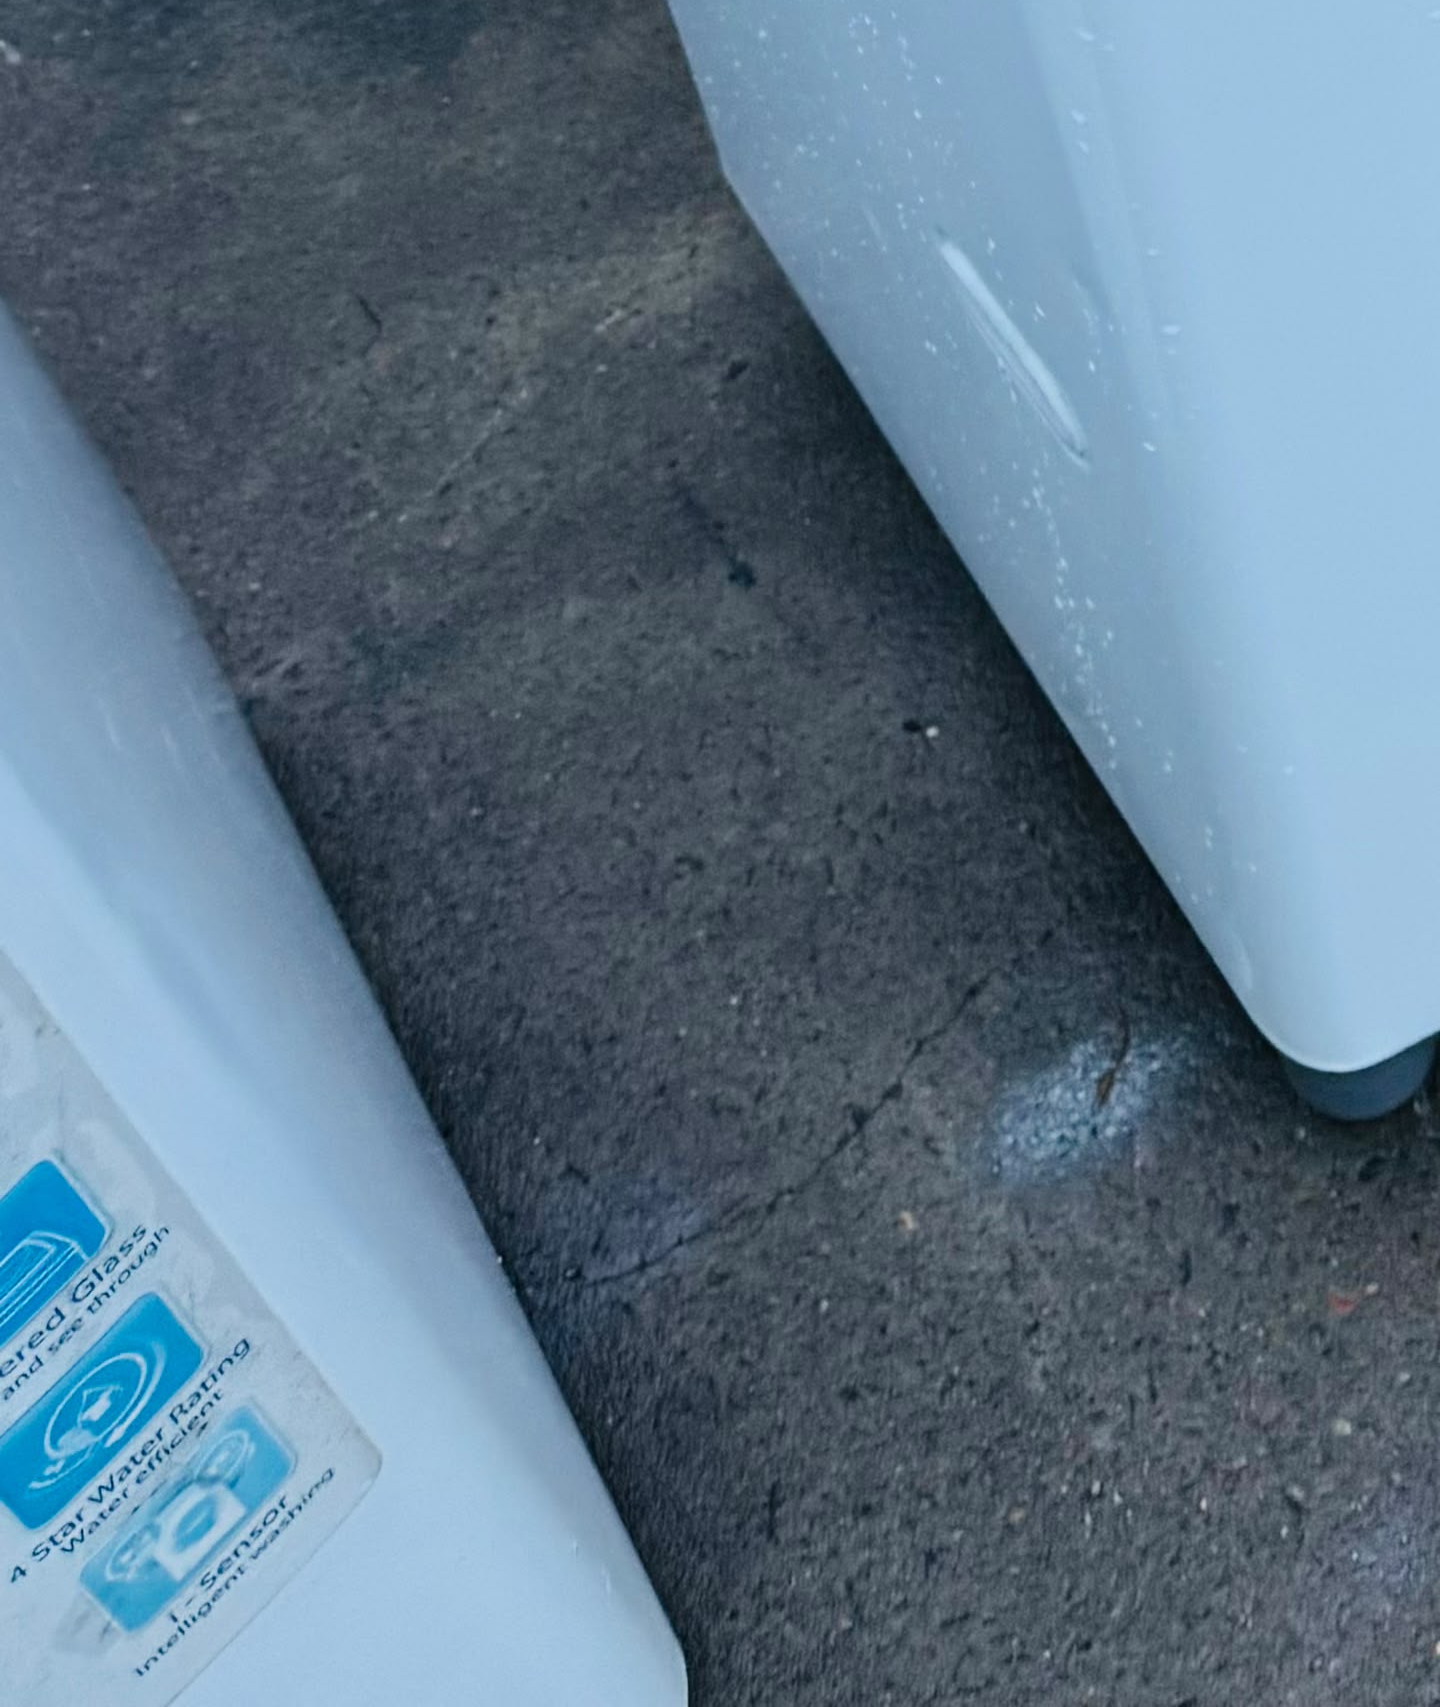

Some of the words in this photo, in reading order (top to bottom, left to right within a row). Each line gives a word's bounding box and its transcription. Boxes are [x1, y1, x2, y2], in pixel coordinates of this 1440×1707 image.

[3, 1355, 44, 1401] and
[47, 1318, 82, 1354] see
[86, 1227, 170, 1315] through
[72, 1225, 146, 1303] Glass
[10, 1565, 28, 1583] 4
[31, 1507, 85, 1563] Star
[88, 1427, 165, 1505] Water
[169, 1338, 251, 1425] Rating
[60, 1488, 130, 1554] Water
[135, 1390, 225, 1486] efficient
[134, 1564, 245, 1678] Intelligent
[251, 1468, 334, 1561] washing
